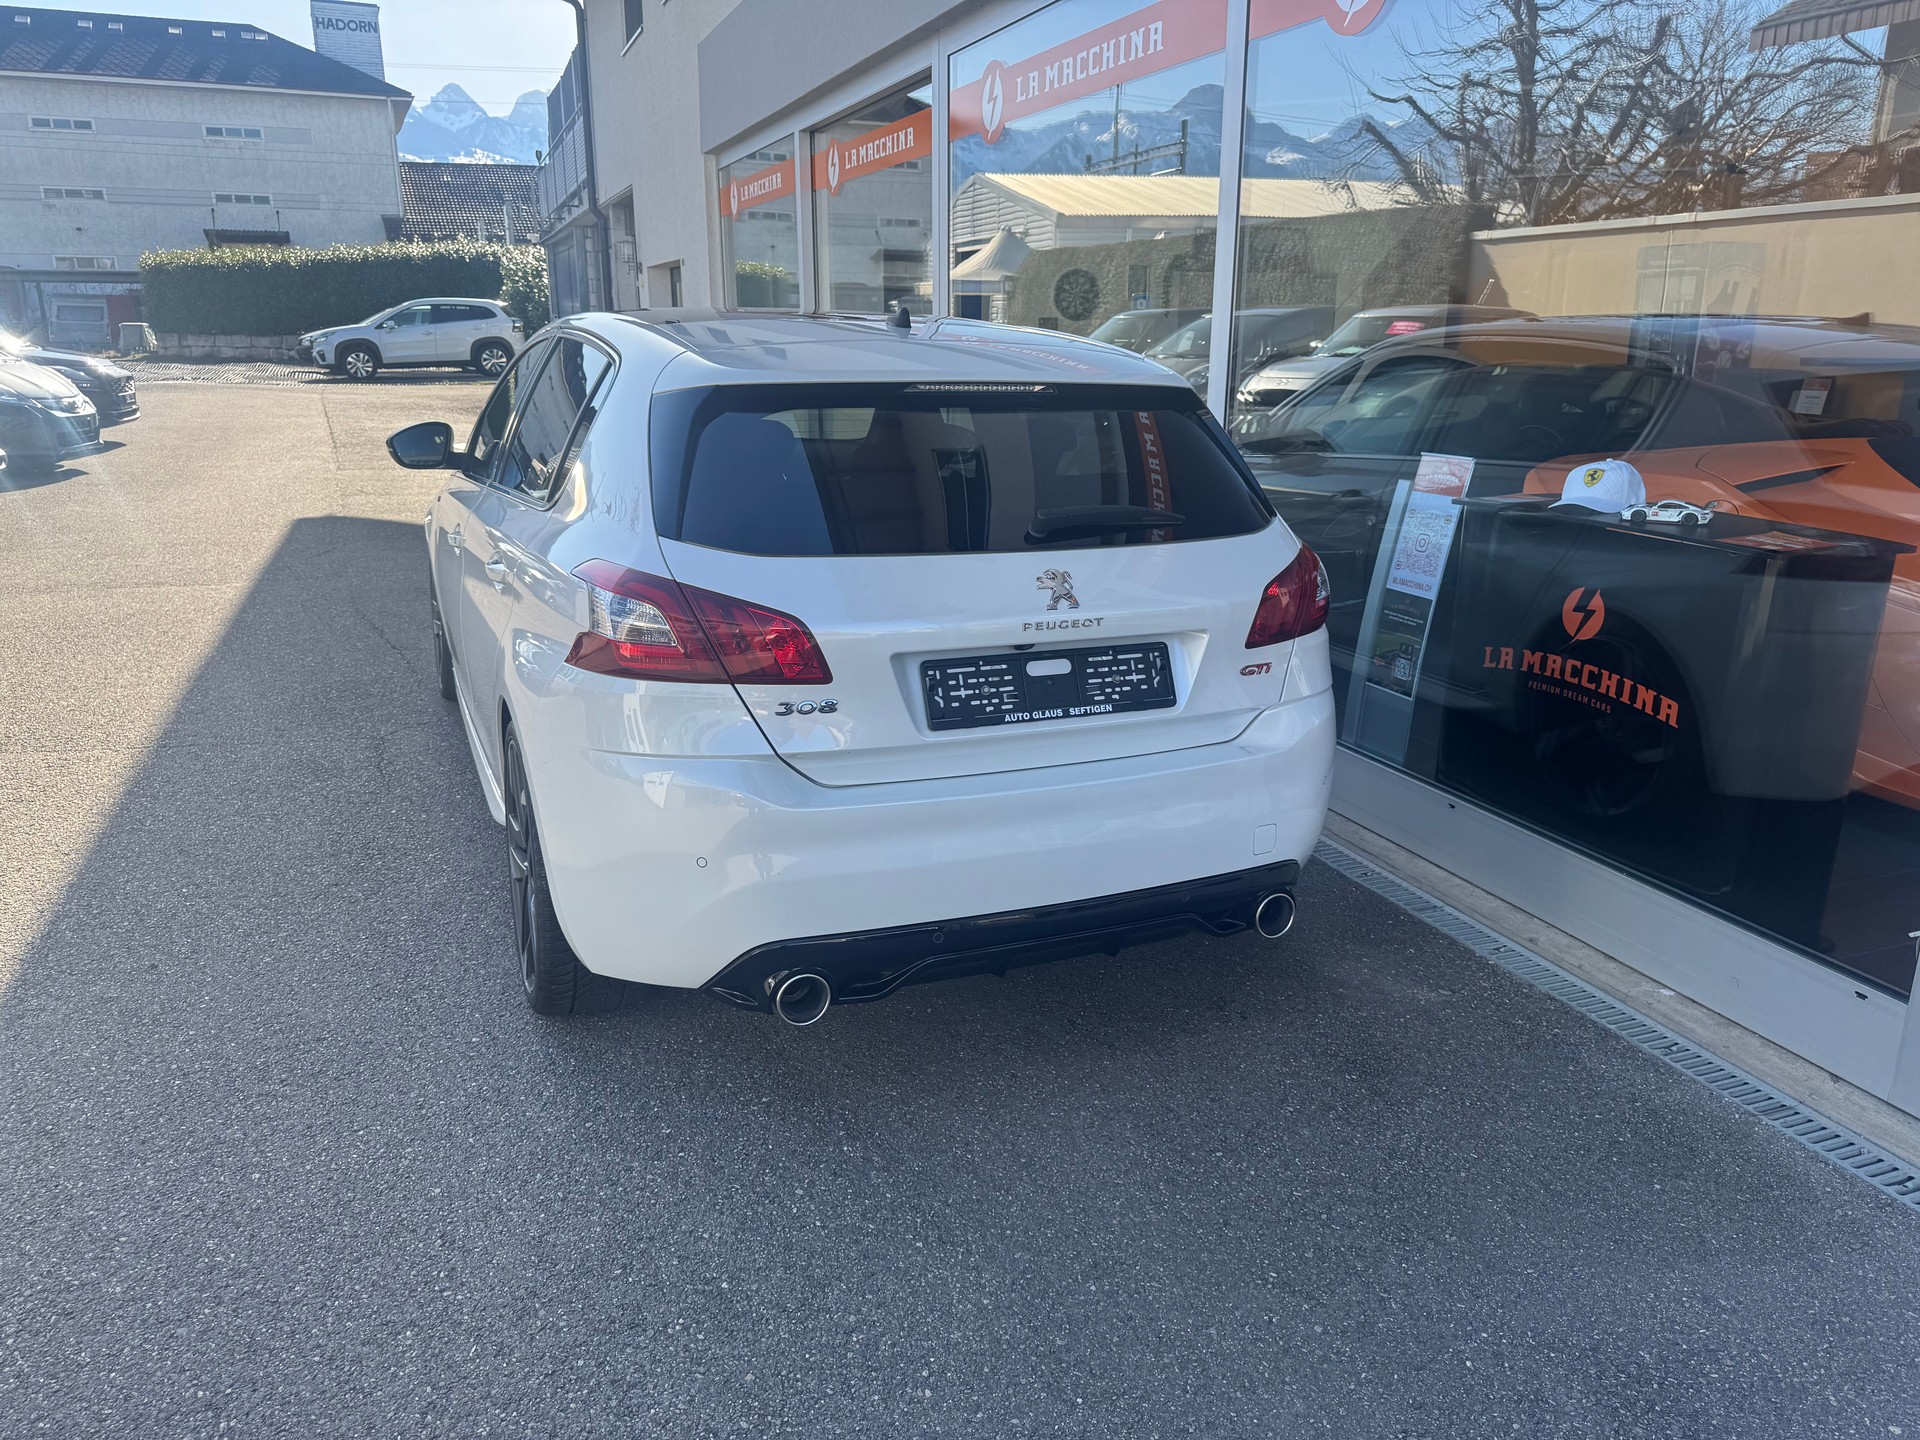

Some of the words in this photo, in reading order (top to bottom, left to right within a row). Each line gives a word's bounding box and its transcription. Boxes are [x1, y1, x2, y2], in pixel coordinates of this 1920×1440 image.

[315, 17, 377, 33] HADORN
[1015, 70, 1040, 103] LA
[1044, 20, 1164, 93] MACCHINA
[845, 148, 857, 170] LA
[858, 126, 915, 164] MACCHINA
[740, 186, 749, 202] LA
[749, 172, 782, 199] MACCHINA
[1022, 617, 1105, 632] PEUGEOT
[1482, 646, 1514, 670] LA
[1520, 648, 1680, 729] MACCHINA
[1527, 680, 1561, 696] PREMIUM
[1562, 688, 1589, 704] DREAM
[1590, 698, 1612, 714] CARS
[774, 698, 838, 717] 308
[1004, 711, 1031, 723] AUTO
[1032, 708, 1064, 721] GLAUS
[1069, 703, 1113, 717] SEFTIGEN
